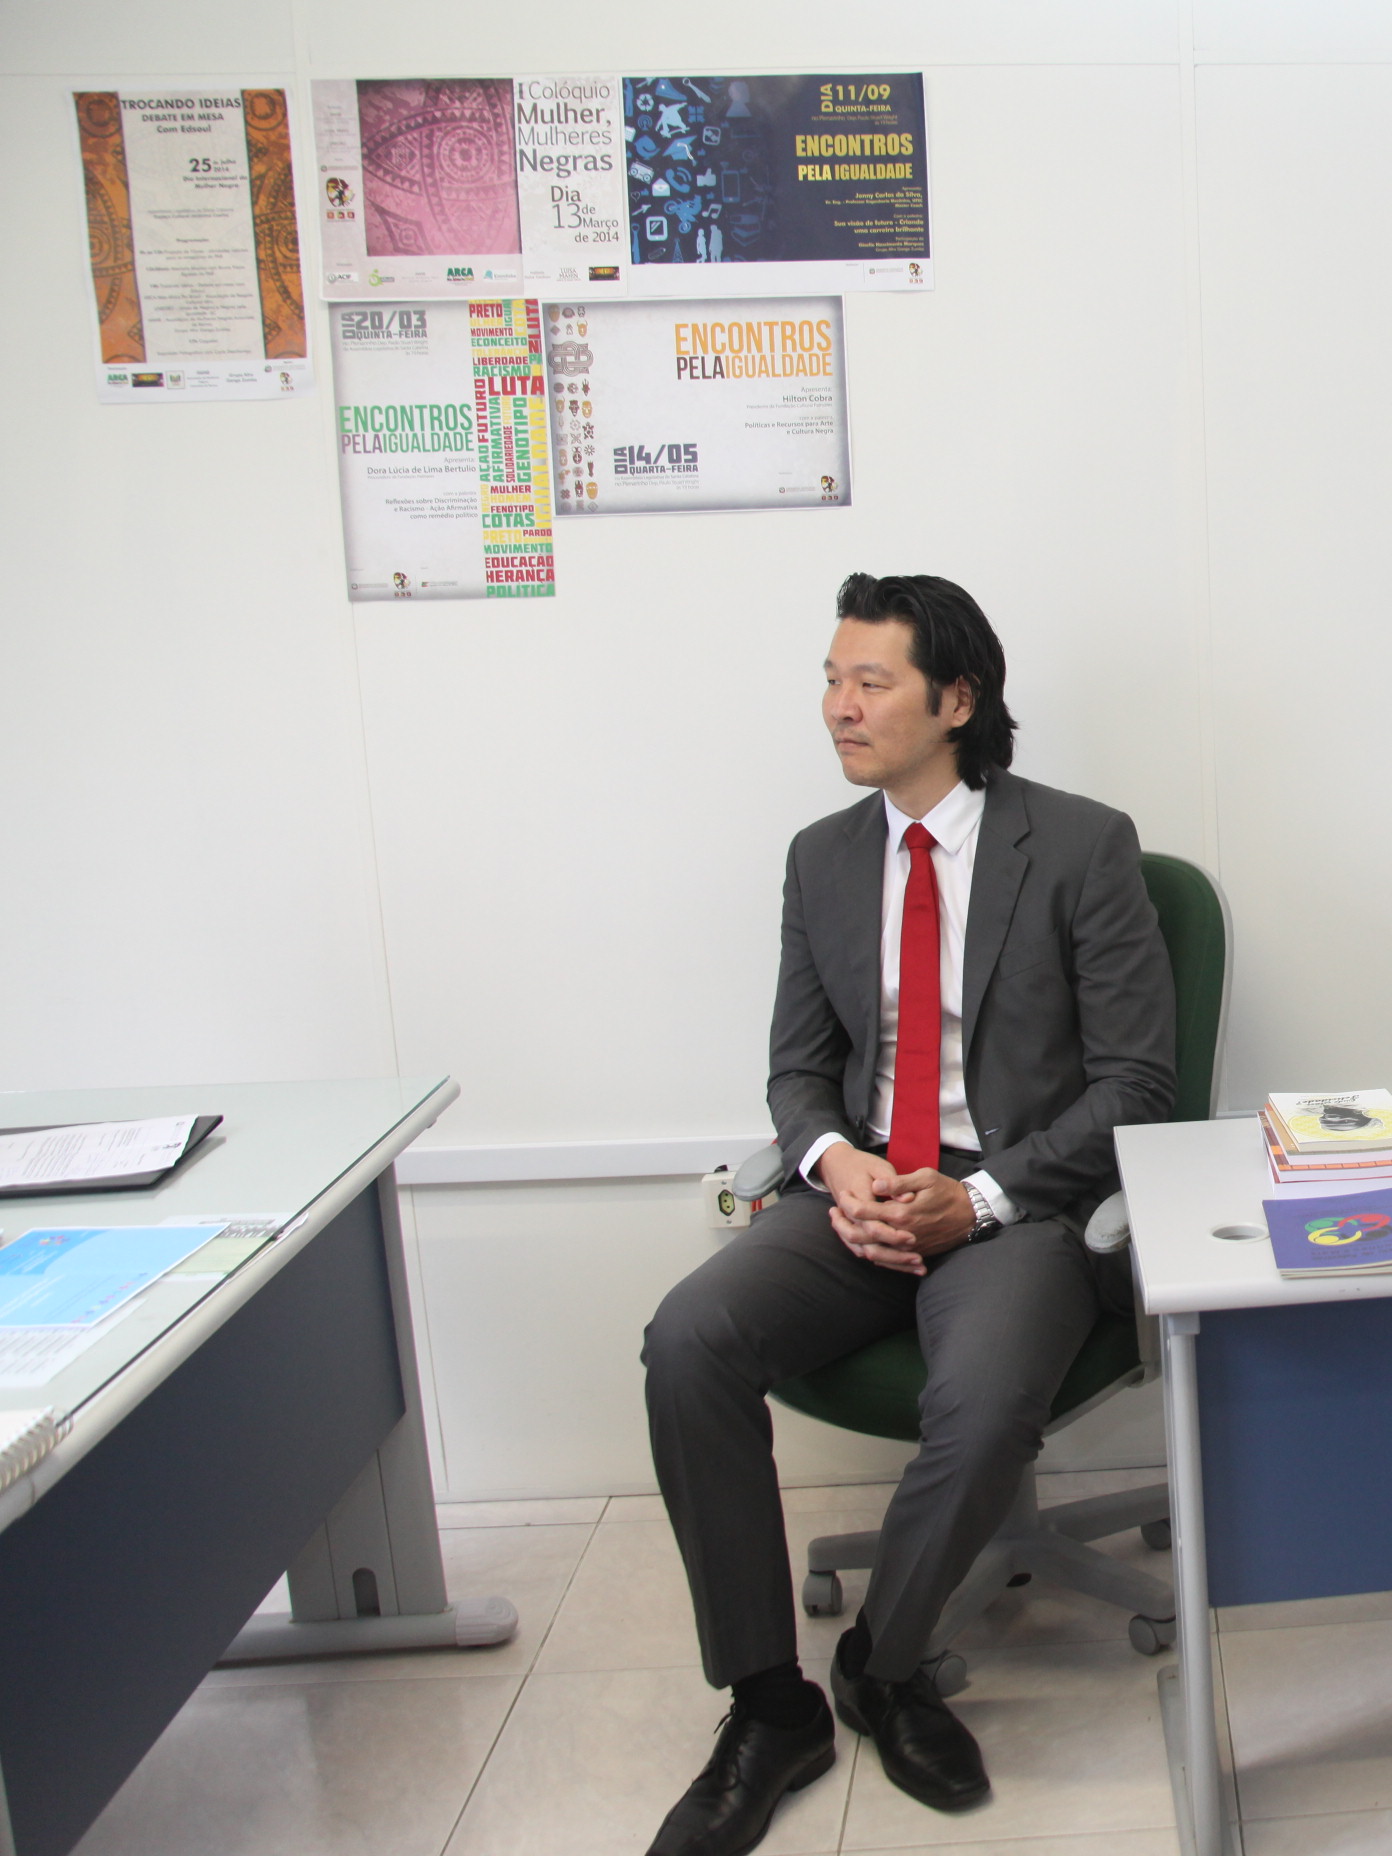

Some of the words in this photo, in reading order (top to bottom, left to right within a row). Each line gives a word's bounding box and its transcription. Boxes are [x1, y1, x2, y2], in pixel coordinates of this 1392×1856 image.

[529, 81, 610, 104] Colóquio
[820, 83, 833, 112] DIA
[836, 84, 891, 101] 11/09
[121, 98, 195, 110] TROCANDO
[200, 97, 241, 108] IDEIAS
[835, 105, 891, 113] QUINTA-FEIRA
[142, 113, 178, 122] DEBATE
[181, 113, 195, 121] EM
[198, 113, 224, 121] MESA
[518, 103, 611, 126] Mulher,
[181, 124, 212, 133] Edsoul
[518, 126, 612, 146] Mulheres
[796, 133, 913, 157] ENCONTROS
[189, 158, 212, 173] 25
[519, 148, 613, 178] Negras
[798, 164, 832, 181] PELA
[834, 163, 913, 180] IGUALDADE
[551, 185, 581, 203] Dia
[553, 204, 582, 229] 13
[582, 204, 596, 215] de
[583, 217, 619, 230] Março
[575, 232, 589, 242] de
[593, 232, 619, 242] 2014
[447, 267, 474, 277] ARCA
[469, 303, 503, 318] PRETO
[342, 313, 356, 340] DIA
[356, 310, 427, 330] 20/03
[356, 330, 428, 340] QUINTA-FEIRA
[470, 328, 513, 337] MOVIMENTO
[674, 320, 832, 355] ENCONTROS
[471, 337, 528, 347] ECONCEITO
[472, 356, 529, 366] LIBERDADE
[473, 365, 531, 377] RACISMO
[488, 375, 545, 396] LUTA
[782, 394, 806, 403] Hilton
[808, 394, 833, 402] Cobra
[339, 403, 473, 433] ENCONTROS
[474, 379, 489, 443] FUTURO
[815, 428, 833, 436] Negra
[488, 397, 505, 483] AFIRMATIVA
[614, 447, 628, 475] DIA
[628, 444, 698, 466] 14/05
[367, 467, 387, 475] Dora
[389, 466, 410, 474] Lúcia
[412, 466, 422, 474] de
[444, 465, 476, 473] Bertulio
[629, 465, 698, 476] QUARTA-FEIRA
[490, 485, 531, 494] MULHER
[435, 497, 477, 505] Discriminação
[456, 512, 478, 520] político
[482, 513, 535, 528] COTAS
[483, 530, 521, 543] PRETO
[523, 528, 552, 537] PARDO
[484, 543, 553, 555] MOVIMENTO
[485, 554, 554, 569] EDUCAÇÃO
[486, 568, 555, 584] HERANÇA
